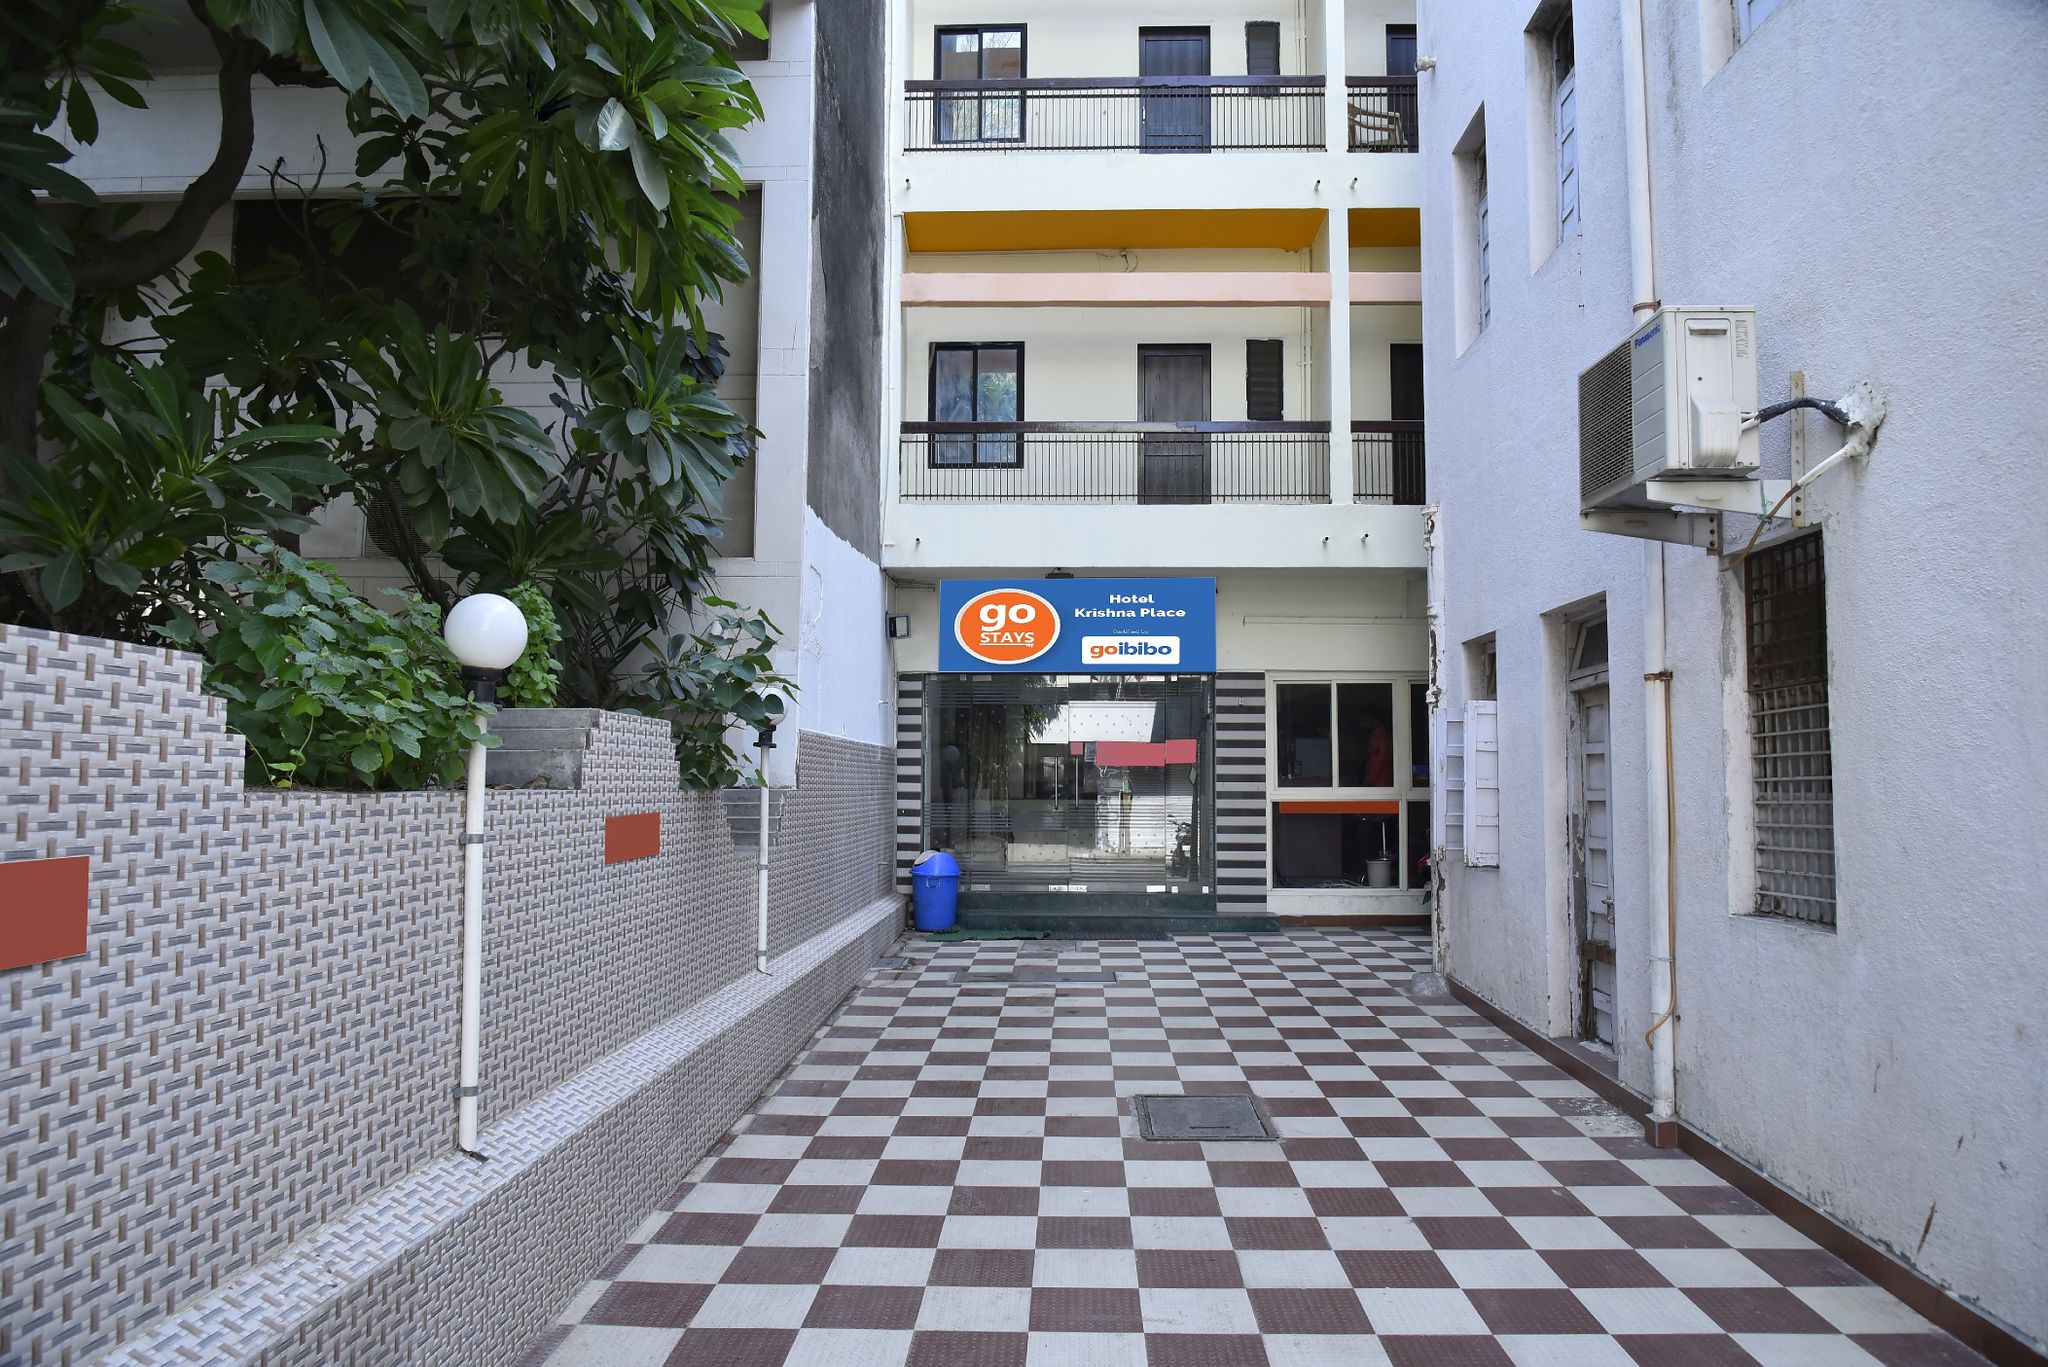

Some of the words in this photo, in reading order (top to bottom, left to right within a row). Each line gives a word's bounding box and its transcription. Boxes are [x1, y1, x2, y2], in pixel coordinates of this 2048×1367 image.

[1110, 595, 1154, 603] Hotel
[979, 603, 1036, 631] go
[1075, 609, 1136, 617] Krishna
[1141, 608, 1185, 617] Place
[981, 632, 1034, 643] STAYS
[1091, 642, 1171, 658] goibibo
